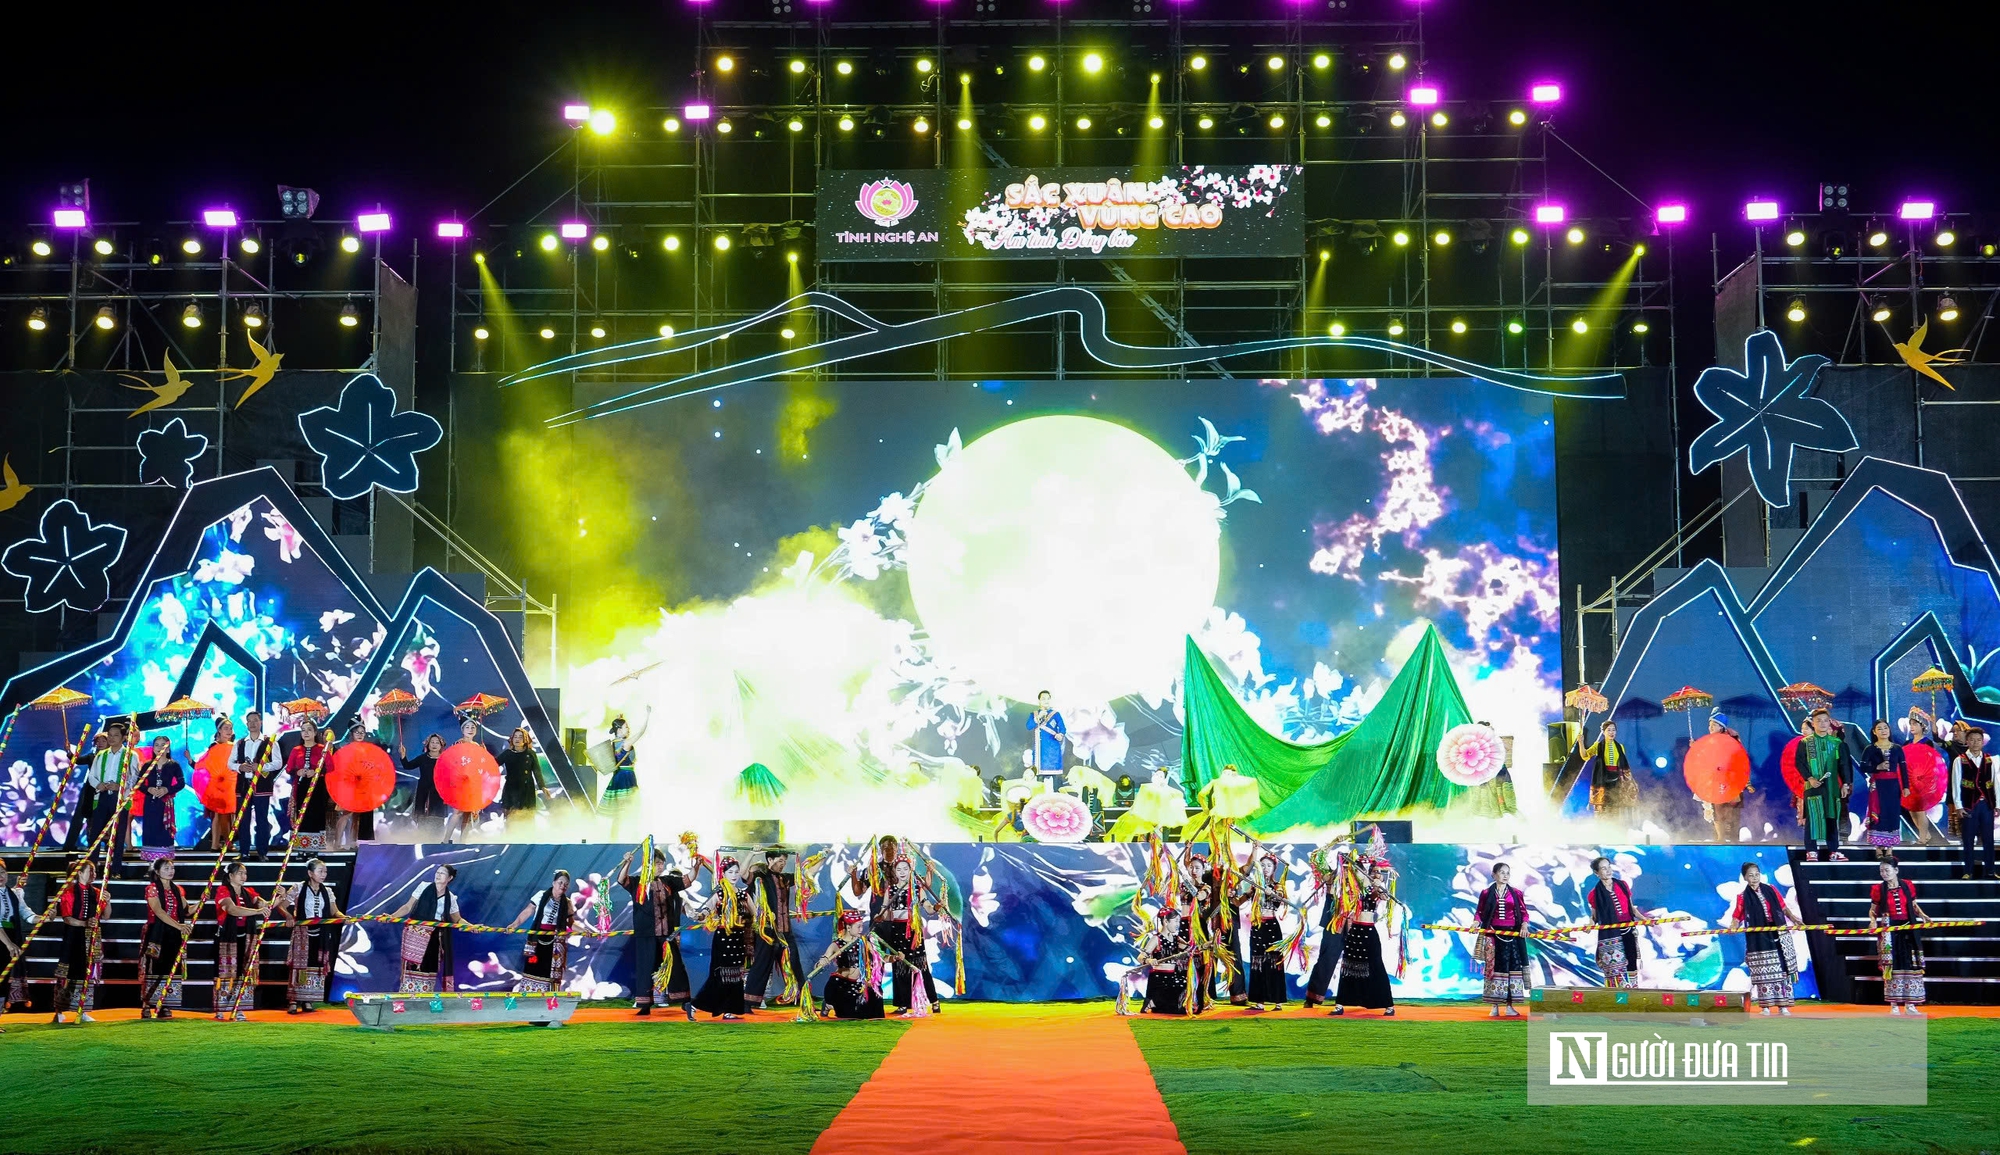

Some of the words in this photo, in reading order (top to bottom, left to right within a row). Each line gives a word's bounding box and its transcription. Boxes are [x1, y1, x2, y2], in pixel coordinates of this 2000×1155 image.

[1078, 201, 1159, 229] VÙNG
[1162, 203, 1223, 229] CAO
[874, 230, 915, 244] NGHỆ
[917, 232, 939, 242] AN
